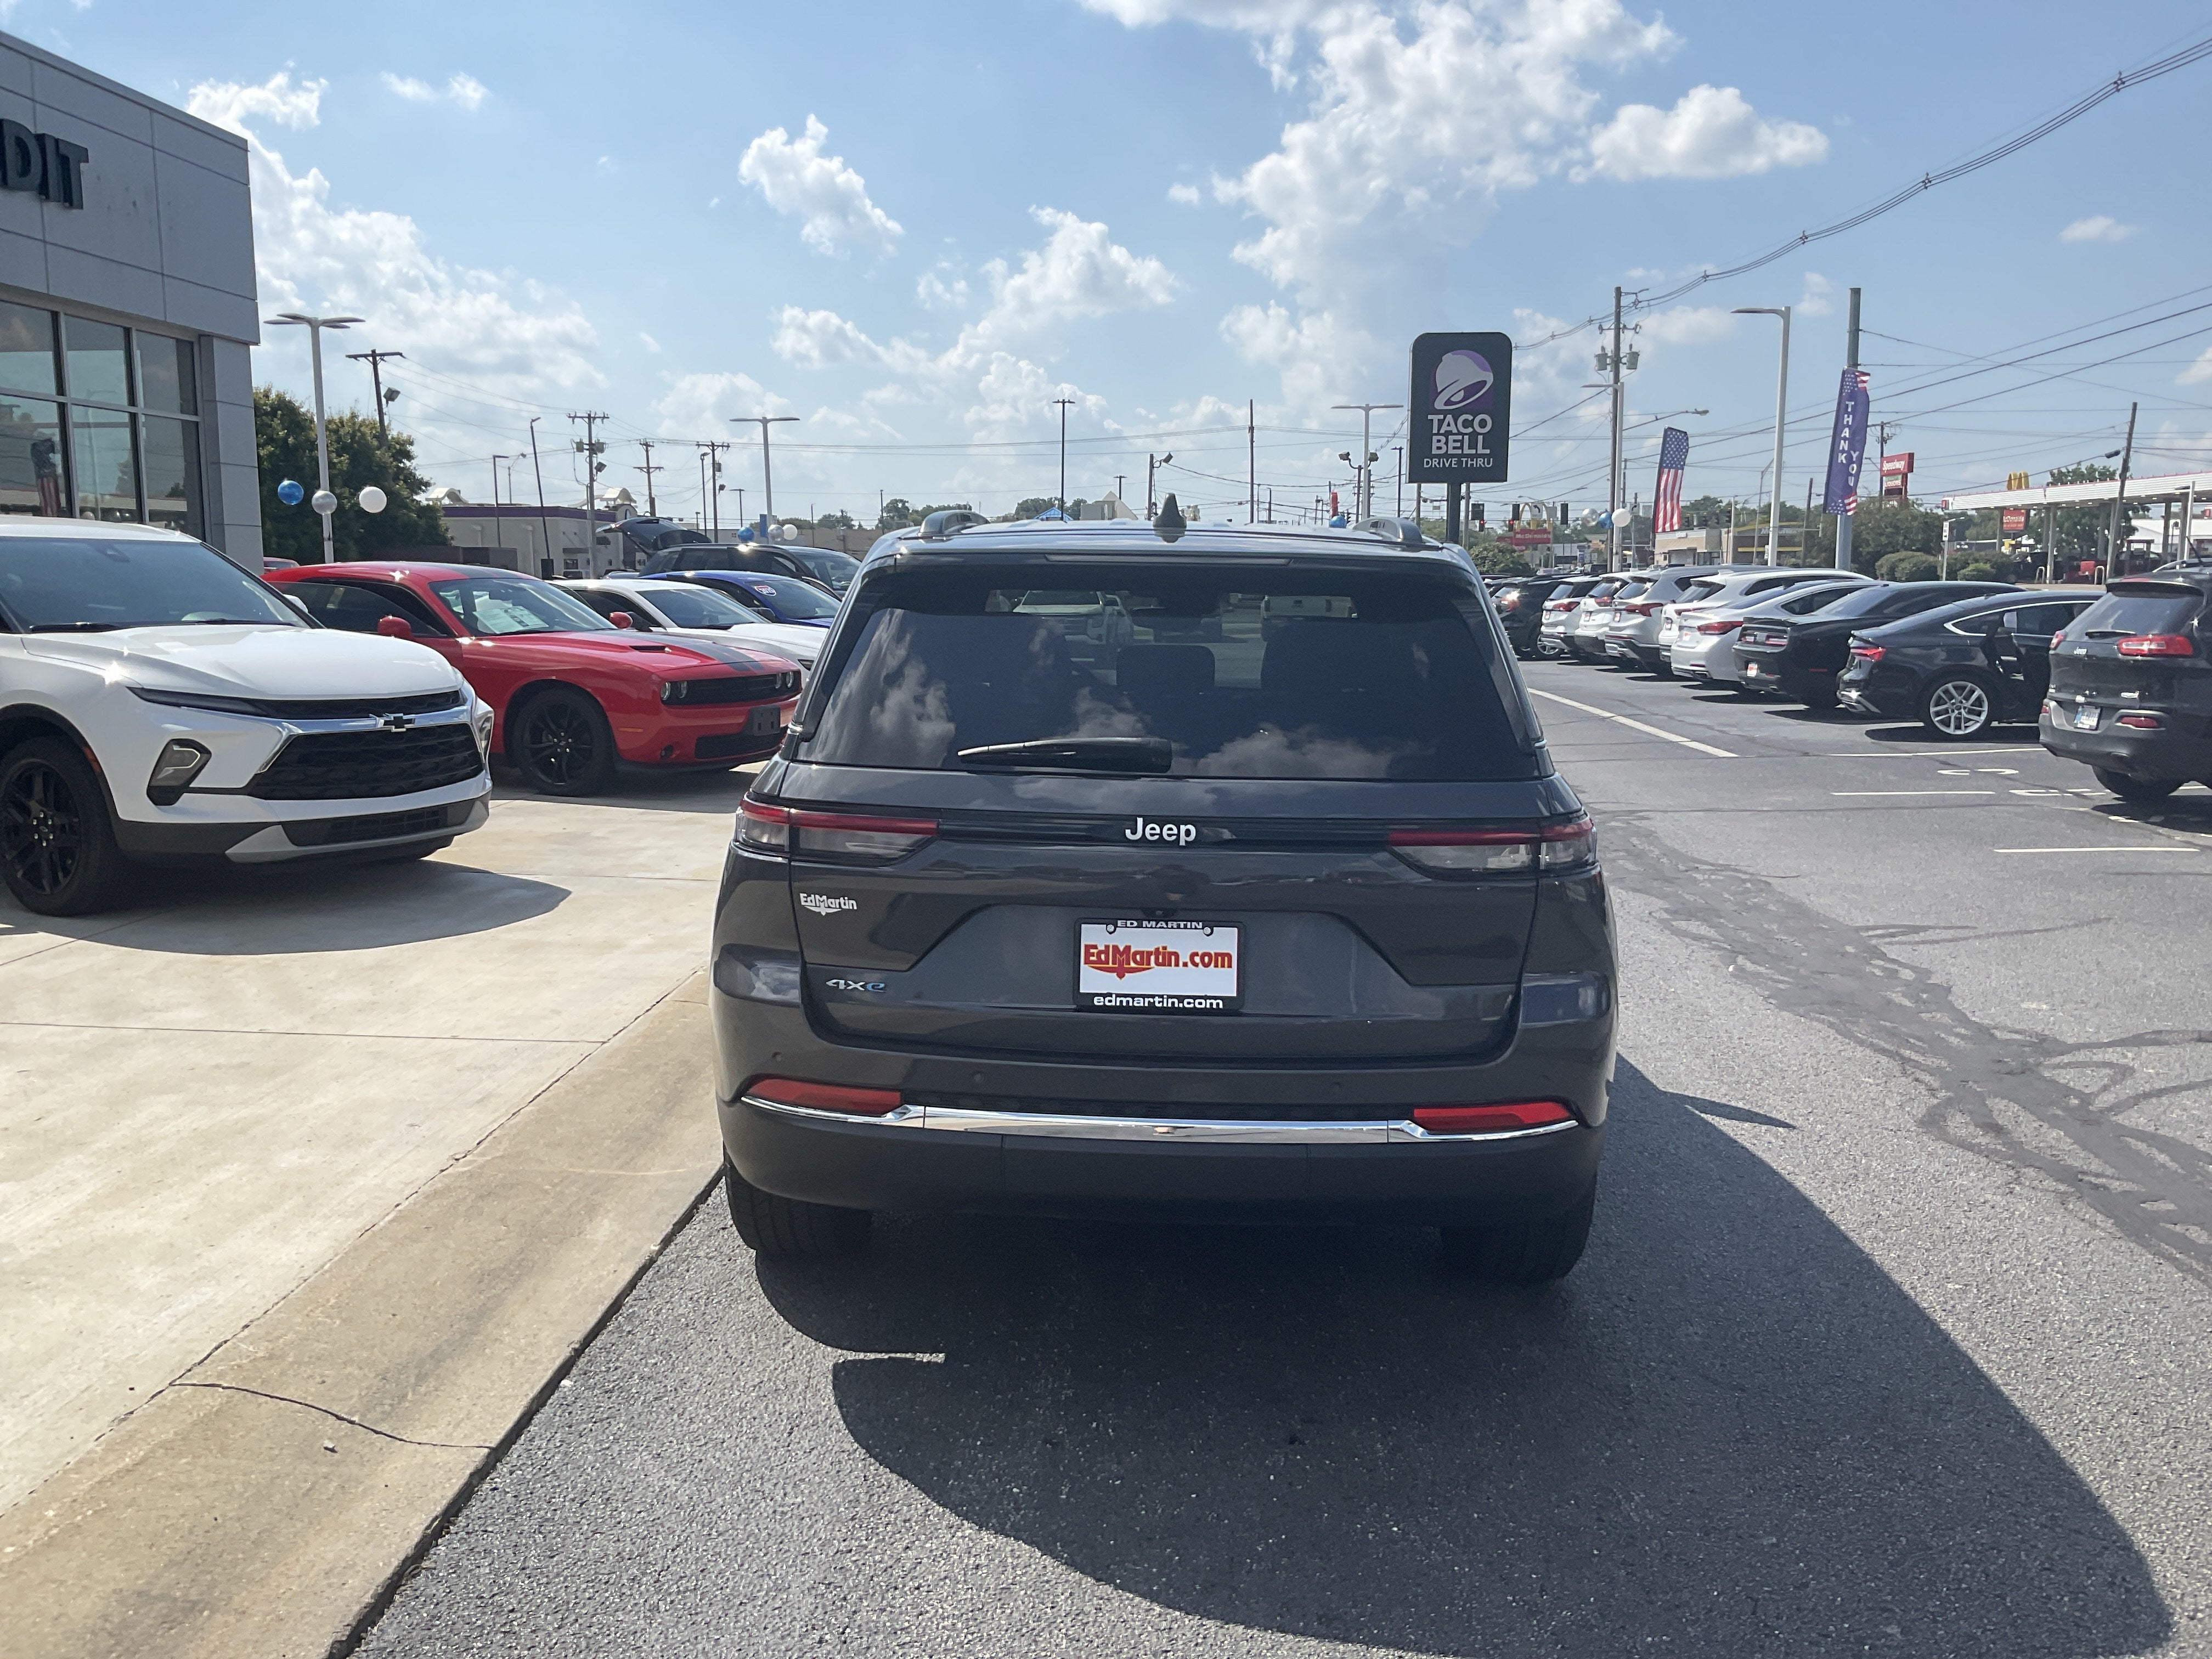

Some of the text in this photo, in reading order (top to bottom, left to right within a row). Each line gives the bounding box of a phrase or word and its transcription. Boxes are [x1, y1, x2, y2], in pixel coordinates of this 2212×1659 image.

[0, 119, 89, 210] DIT
[1427, 414, 1492, 433] TACO
[1431, 435, 1491, 454] BELL
[1838, 401, 1859, 487] THANK YOU
[1423, 458, 1493, 468] DRIVE THRU
[1882, 459, 1905, 473] Speedway
[1125, 817, 1197, 846] Jeep
[1143, 921, 1203, 929] MARTIN
[1084, 944, 1233, 971] EdMartin.com
[1093, 994, 1223, 1009] edmartin.com
